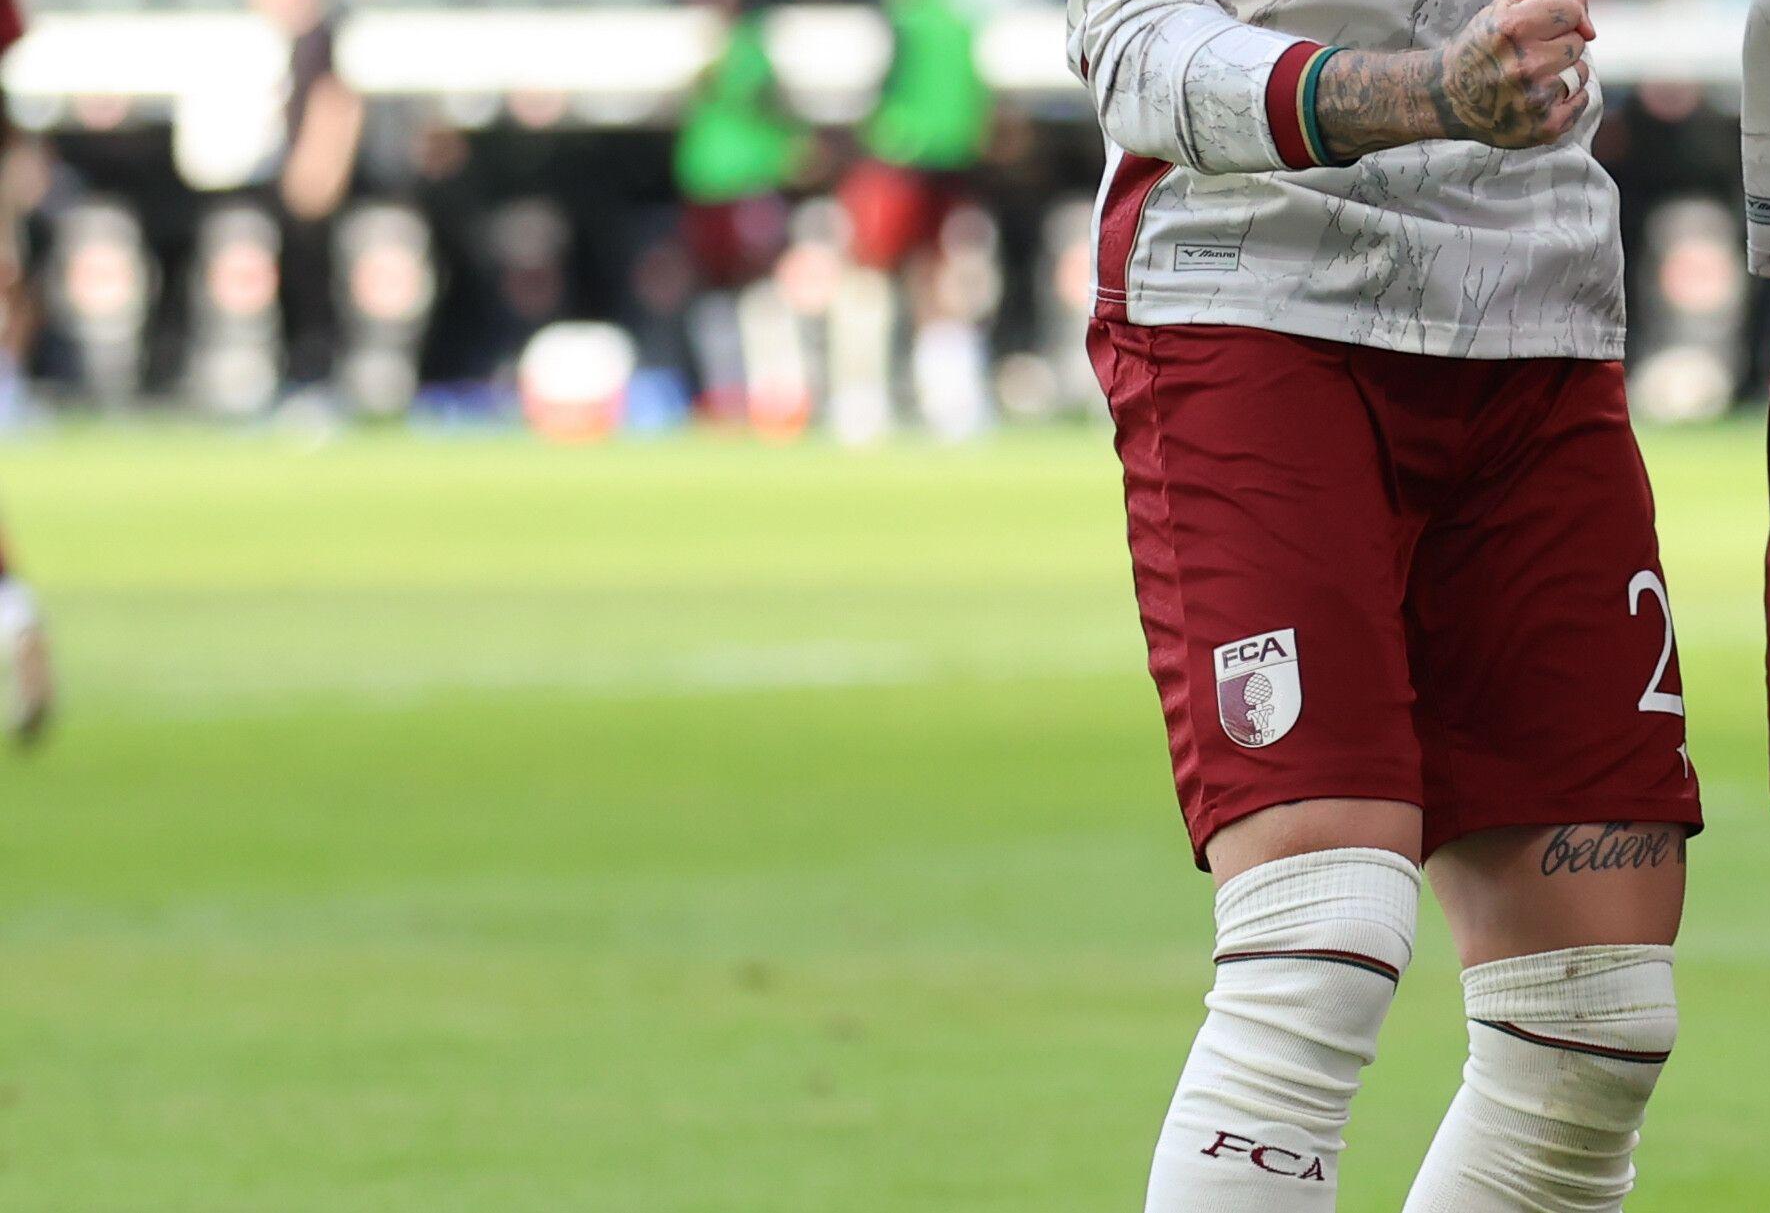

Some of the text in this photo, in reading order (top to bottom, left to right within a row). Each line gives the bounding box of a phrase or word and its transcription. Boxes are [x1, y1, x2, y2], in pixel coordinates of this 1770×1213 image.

[1221, 636, 1289, 669] FCA
[1627, 569, 1685, 717] 2
[1200, 1130, 1326, 1182] FCA
